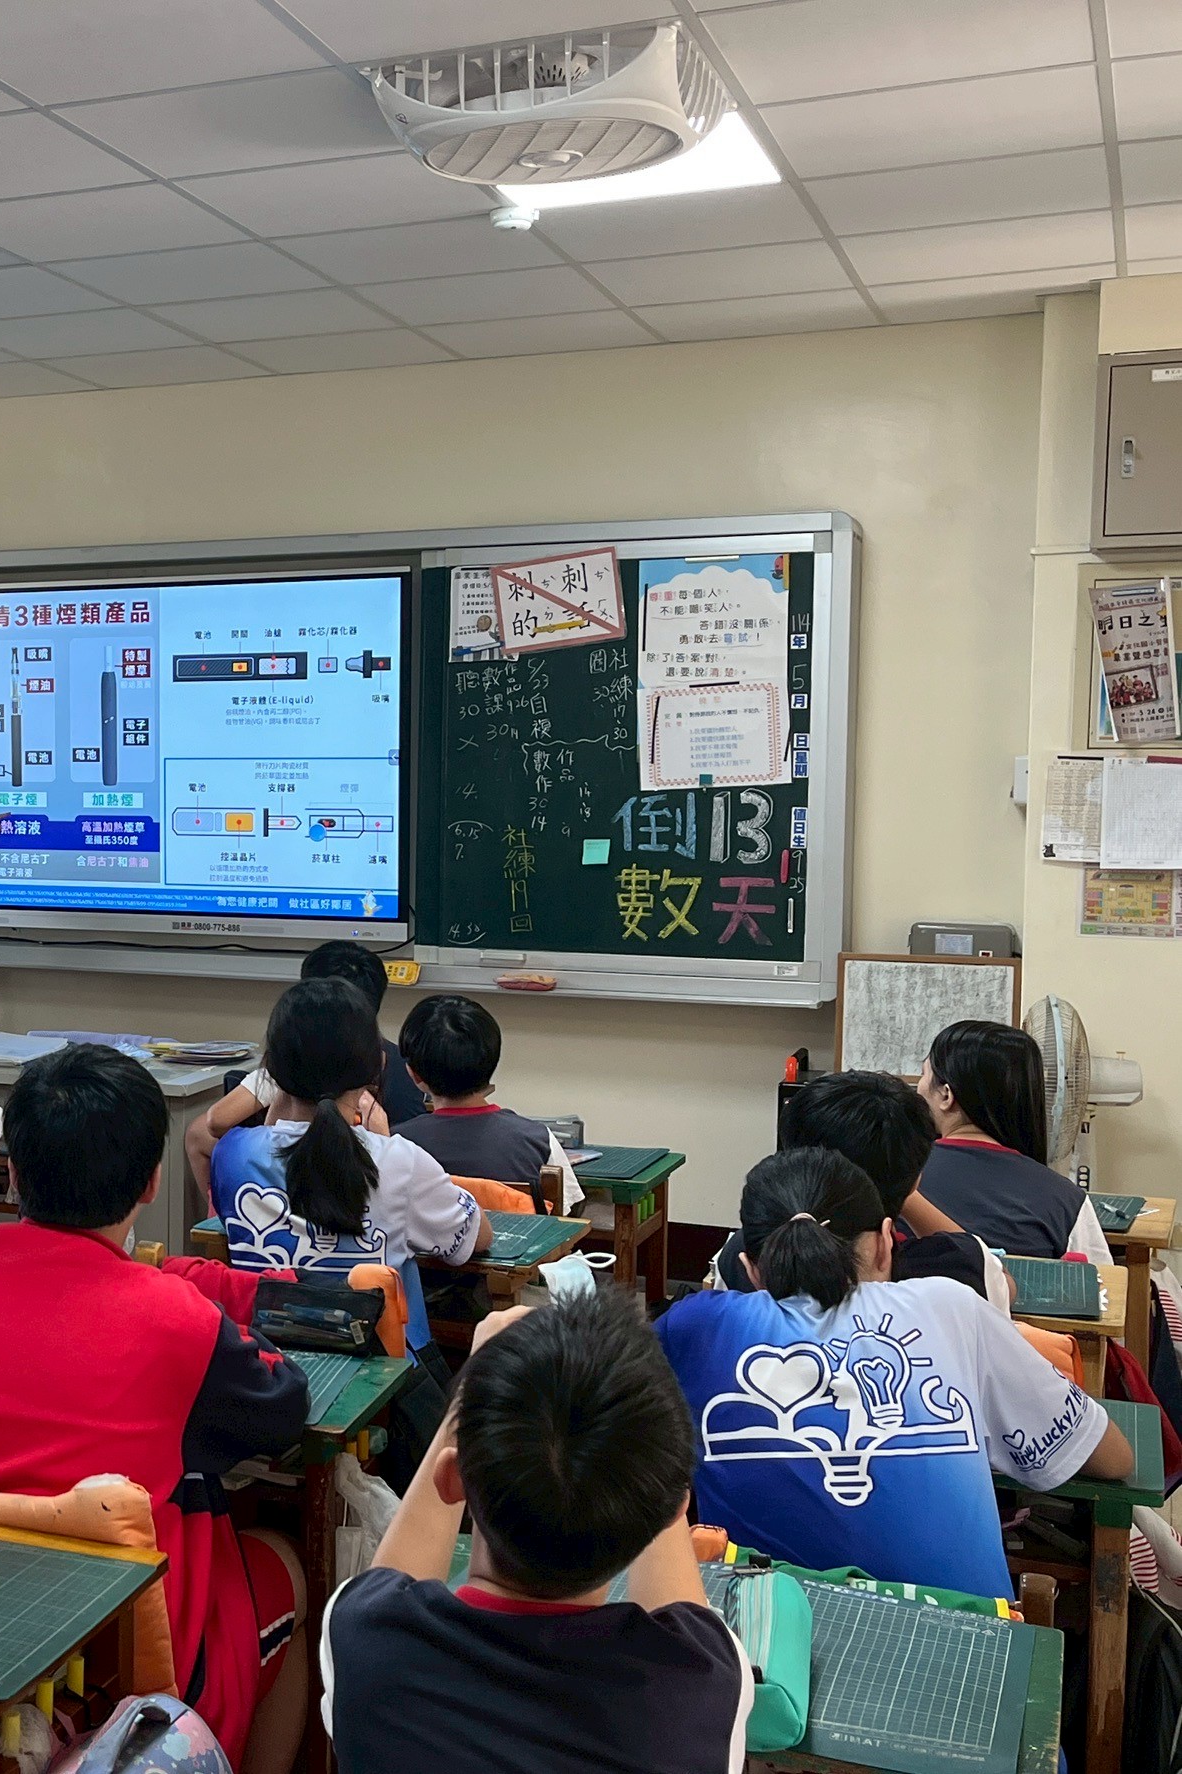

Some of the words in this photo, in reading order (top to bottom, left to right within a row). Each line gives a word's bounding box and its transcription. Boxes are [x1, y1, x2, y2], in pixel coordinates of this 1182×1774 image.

[194, 631, 211, 640] 電池
[124, 665, 148, 676] 煙草
[792, 664, 808, 690] 5
[29, 680, 51, 691] 煙油
[793, 695, 806, 707] 月
[126, 719, 147, 730] 電子
[126, 734, 147, 744] 組件
[796, 735, 808, 747] 日
[28, 753, 50, 763] 電池
[75, 750, 97, 761] 電池
[795, 752, 808, 776] 星期
[189, 783, 206, 792] 電池
[92, 793, 134, 806] 加熱煙
[81, 821, 145, 833] 高溫加熱煙草
[710, 788, 773, 864] 13
[793, 808, 807, 848] 值日生
[85, 835, 138, 845] 至攝氏350度
[76, 855, 149, 868] 含尼古丁和焦油
[712, 877, 776, 945] 天
